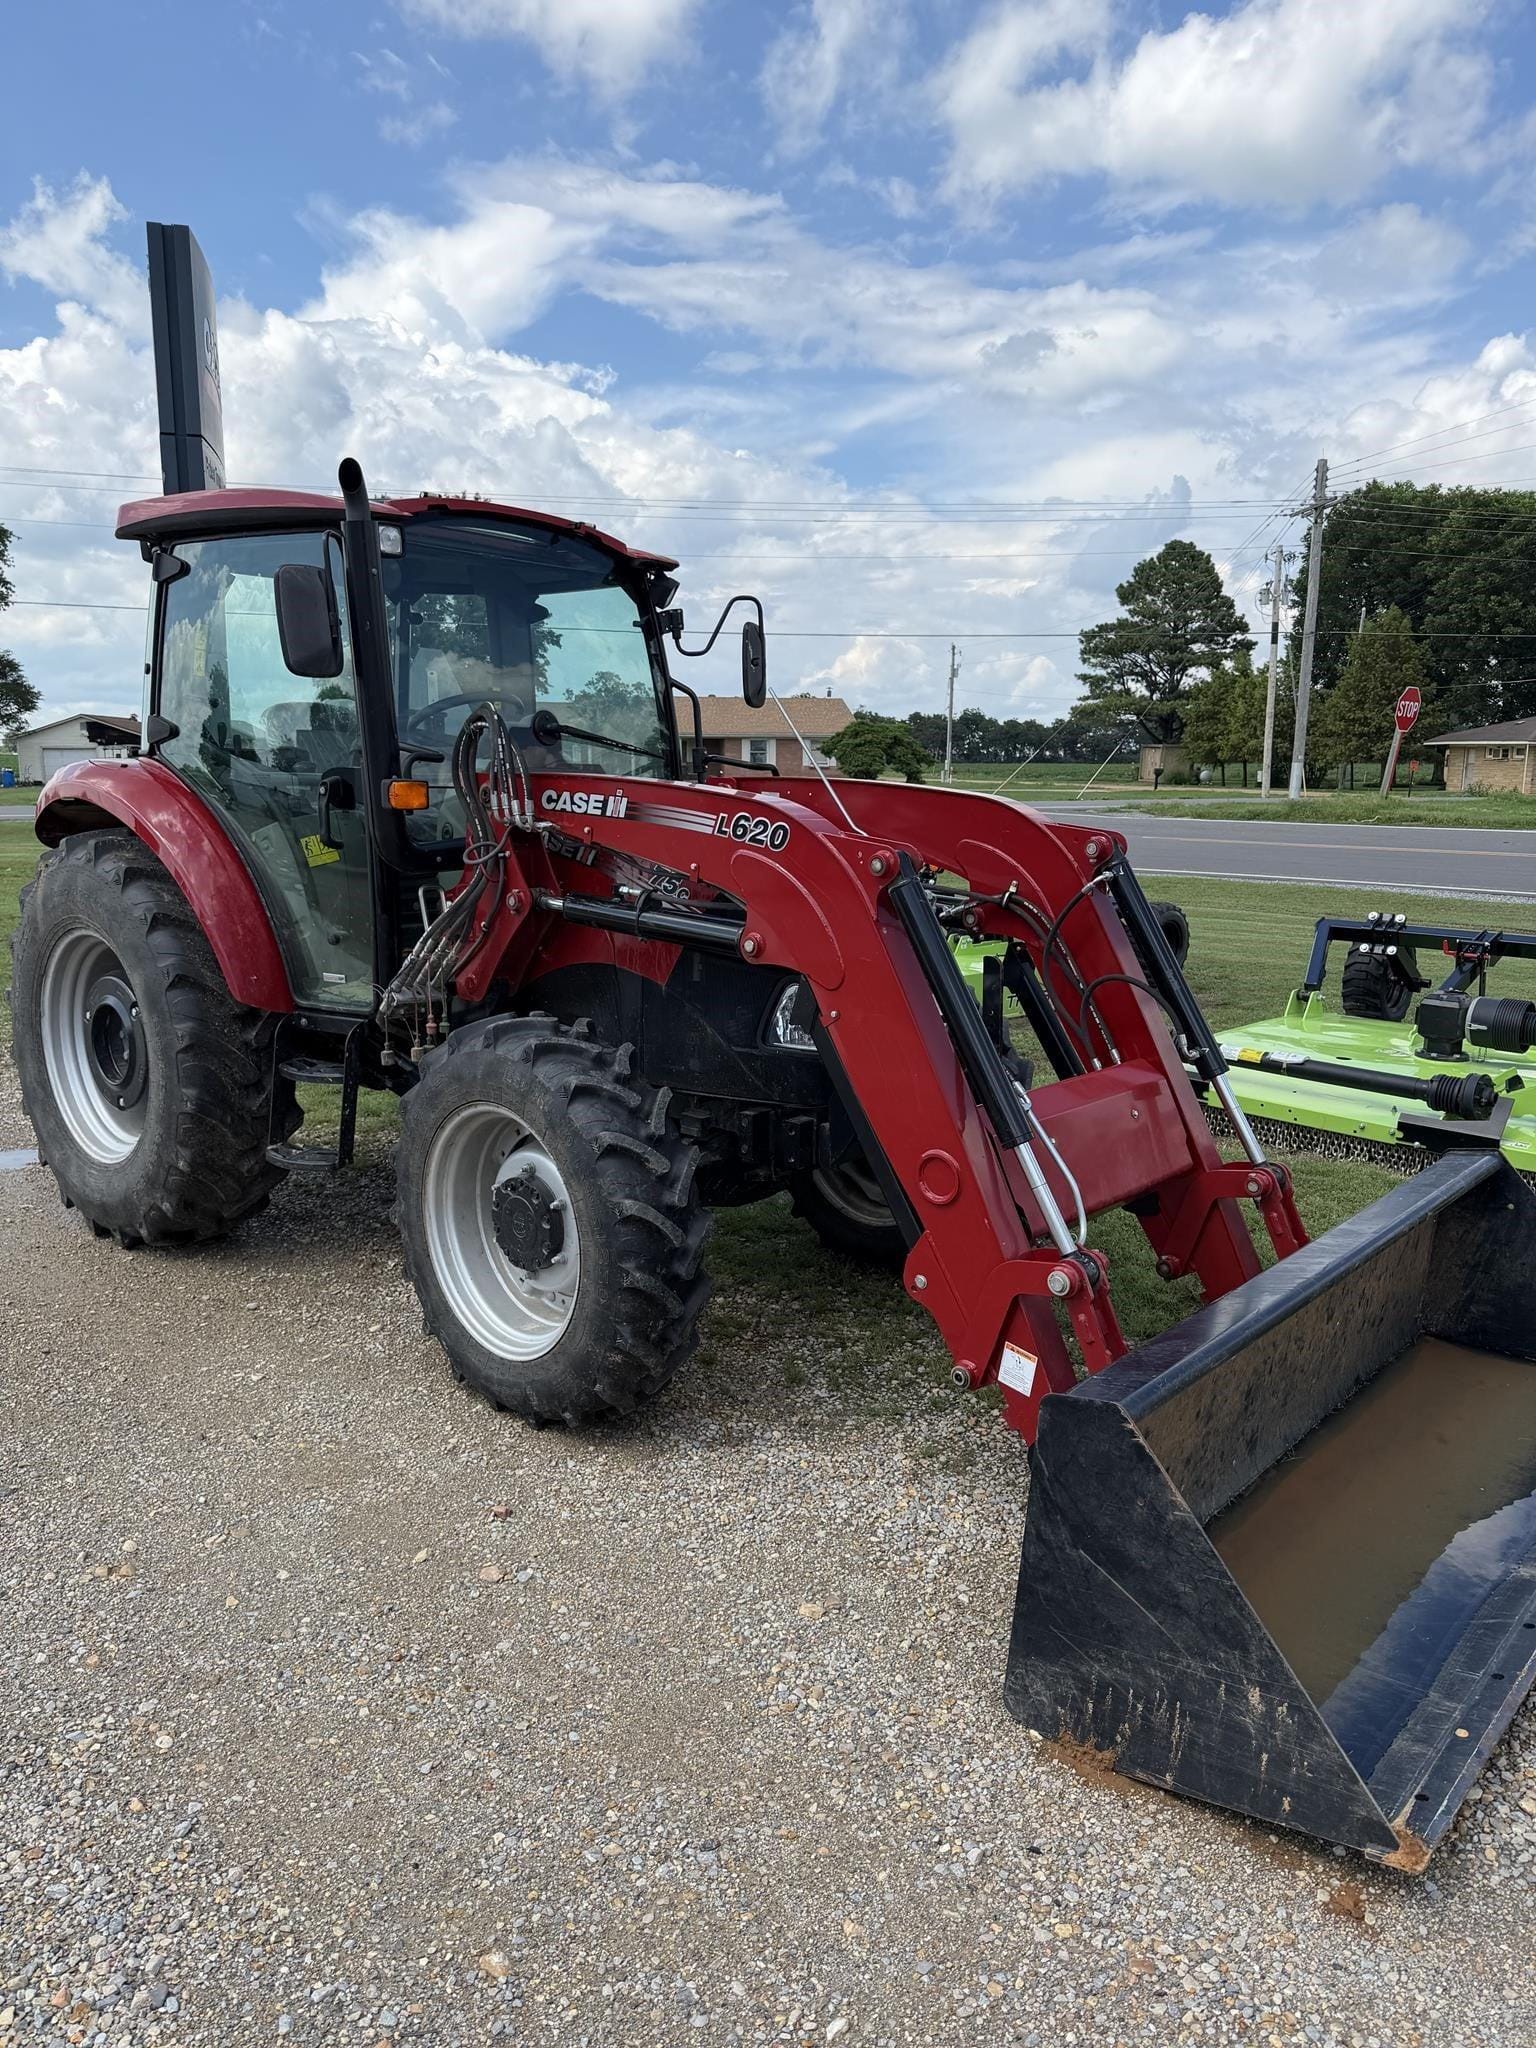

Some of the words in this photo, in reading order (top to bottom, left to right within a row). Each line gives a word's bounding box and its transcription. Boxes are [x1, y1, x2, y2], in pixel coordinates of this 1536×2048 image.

[1398, 701, 1419, 718] STOP
[541, 789, 605, 816] CASE
[714, 812, 791, 852] L620
